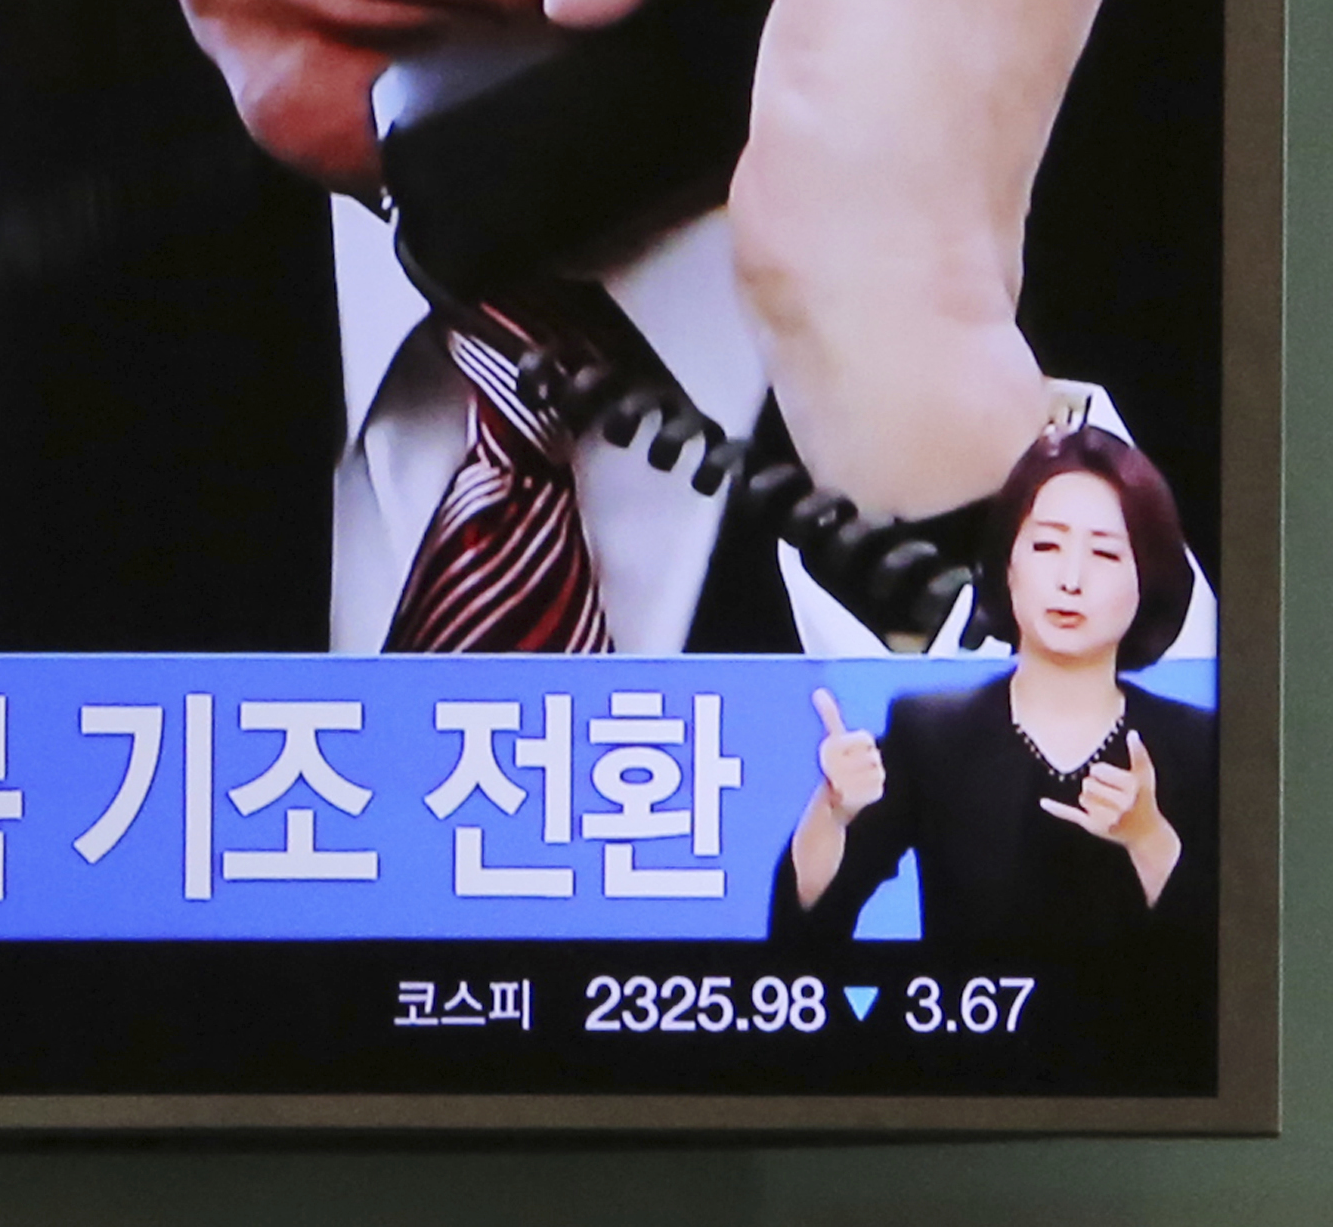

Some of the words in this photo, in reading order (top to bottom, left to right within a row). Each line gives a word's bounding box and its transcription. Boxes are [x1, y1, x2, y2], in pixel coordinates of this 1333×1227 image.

[73, 692, 379, 901] 기조
[423, 691, 743, 899] 전환
[393, 979, 531, 1030] 코스피
[583, 975, 828, 1033] 2325.98
[904, 975, 1036, 1034] 3.67
